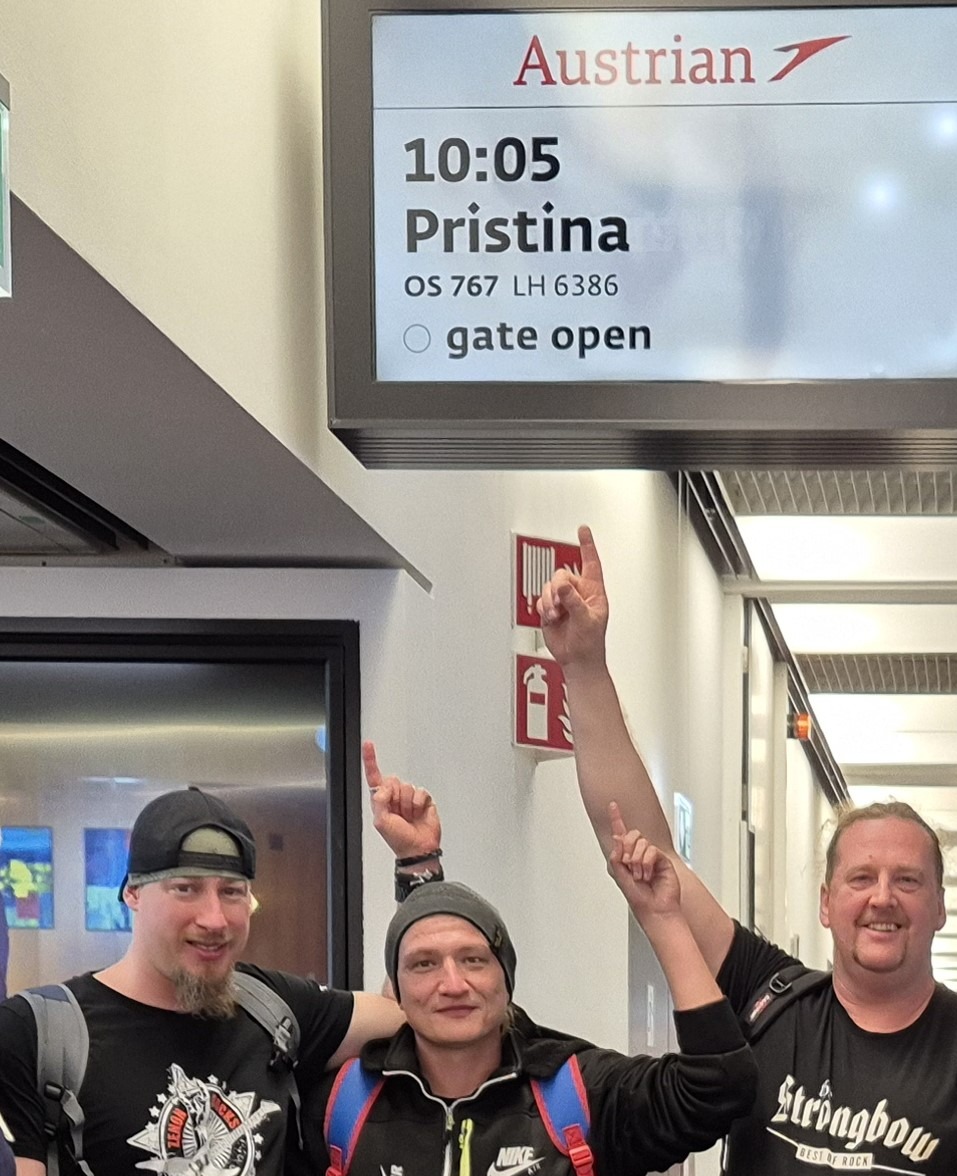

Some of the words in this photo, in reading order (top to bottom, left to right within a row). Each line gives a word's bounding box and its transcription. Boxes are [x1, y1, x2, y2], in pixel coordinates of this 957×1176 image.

[513, 34, 757, 87] Austrian
[404, 136, 561, 184] 10:05
[405, 202, 631, 254] Pristina
[404, 274, 443, 299] OS
[450, 274, 499, 298] 767
[512, 274, 546, 298] LH
[554, 273, 619, 298] 6386
[446, 321, 539, 360] gate
[551, 320, 653, 360] open
[770, 1074, 941, 1163] Strongbow
[496, 1146, 535, 1167] NIKE
[799, 1147, 823, 1161] BEST
[826, 1152, 838, 1165] OF
[842, 1155, 869, 1167] ROCK
